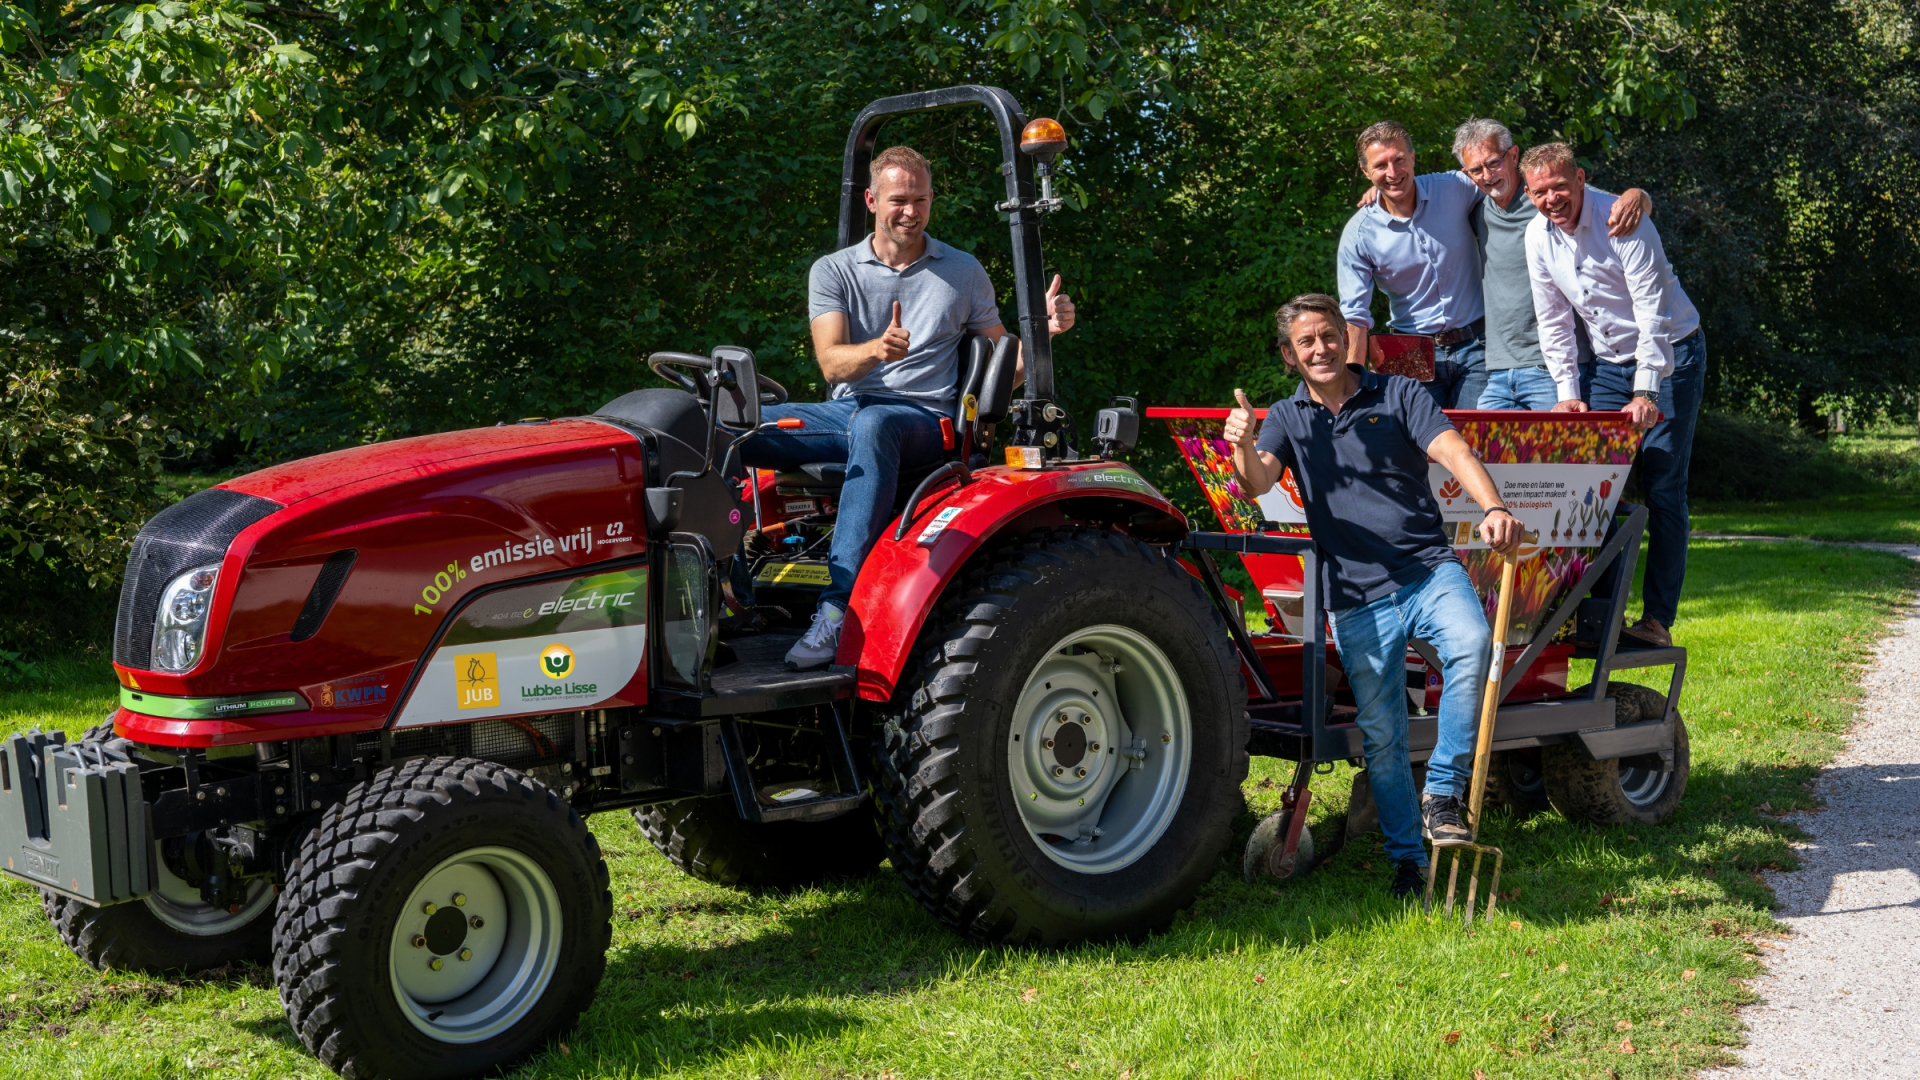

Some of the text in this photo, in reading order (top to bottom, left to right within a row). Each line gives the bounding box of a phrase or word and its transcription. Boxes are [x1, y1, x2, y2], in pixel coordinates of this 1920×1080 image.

[1094, 473, 1144, 486] electric
[1504, 481, 1517, 489] Doe
[1538, 481, 1555, 489] laten
[1502, 490, 1567, 499] samen impact maken!
[1503, 500, 1553, 510] 00% biologisch
[597, 536, 633, 545] HOGERVORST
[414, 526, 593, 616] 100% emissie vrij
[538, 591, 636, 616] electric
[335, 685, 387, 703] KWPN
[463, 687, 494, 705] JUB
[521, 682, 598, 698] Lubbe Lisse
[215, 698, 293, 711] LITHIUM POWERED
[979, 772, 1029, 875] ALLIANCE
